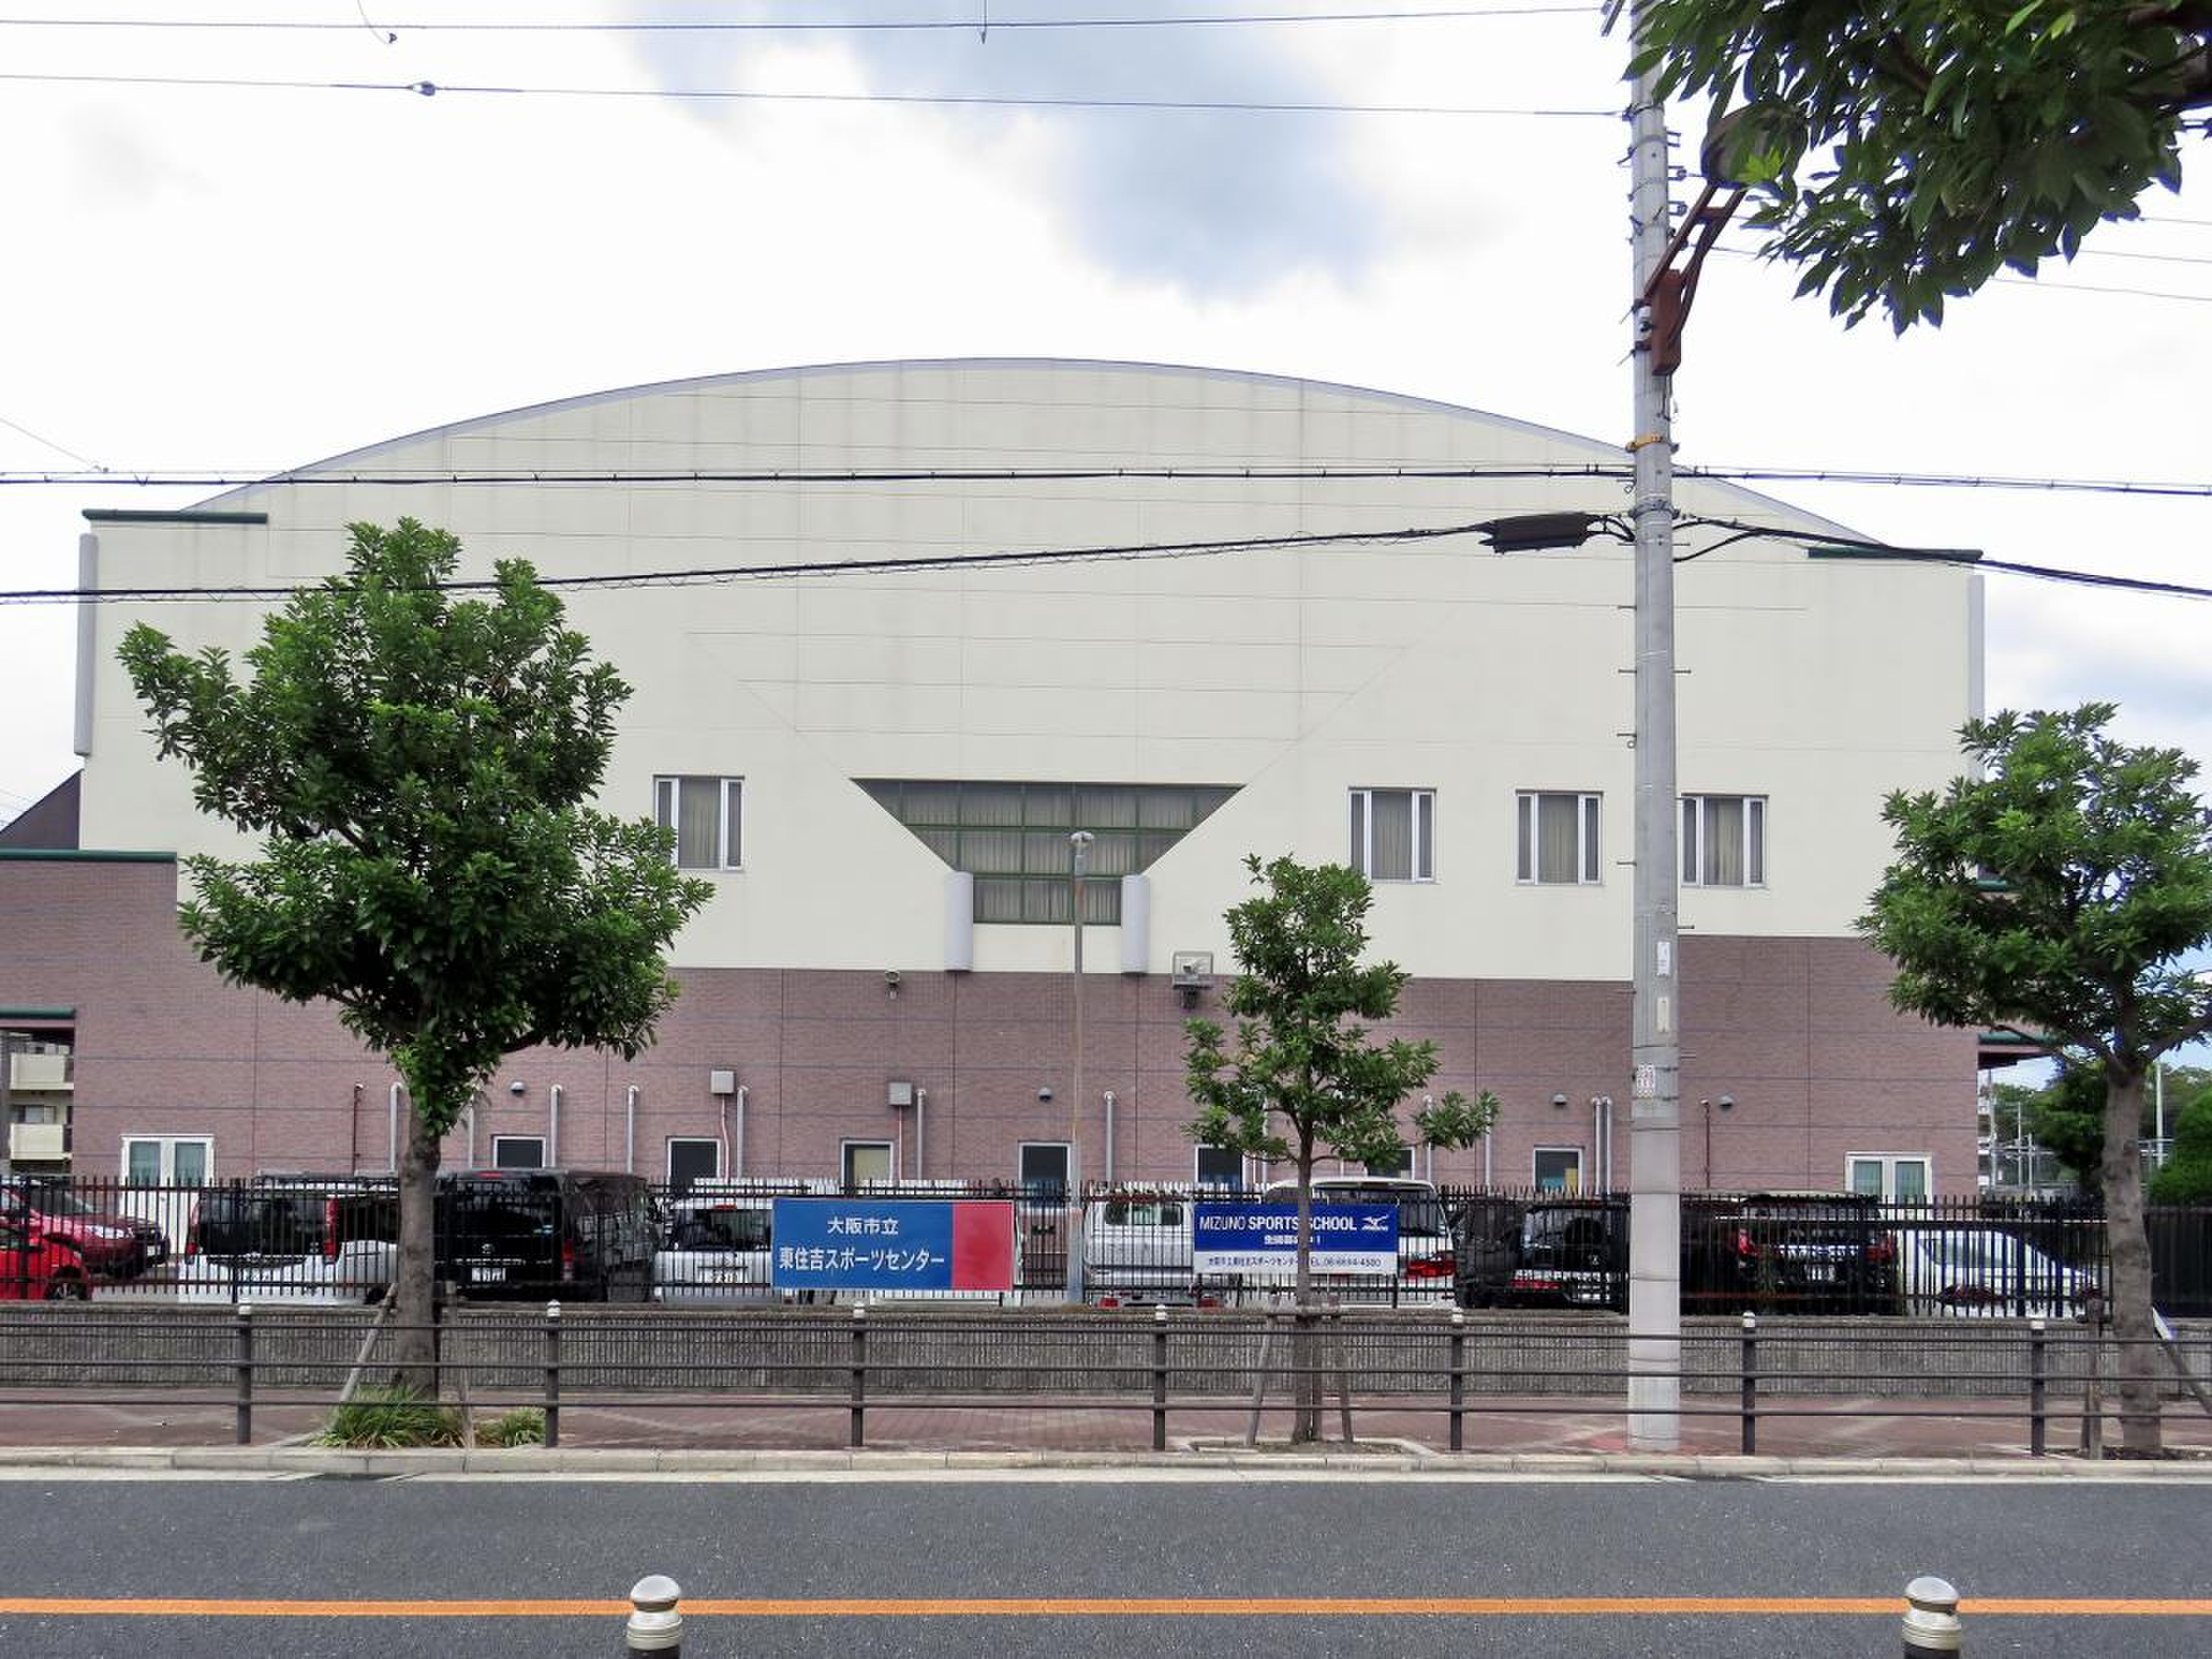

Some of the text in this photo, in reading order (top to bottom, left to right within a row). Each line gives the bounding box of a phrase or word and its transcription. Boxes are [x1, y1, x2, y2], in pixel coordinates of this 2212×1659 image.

[827, 1218, 900, 1235] 大阪市立
[1199, 1217, 1245, 1230] MIZUNO
[1248, 1216, 1299, 1230] SPORTS
[779, 1247, 945, 1271] 東住吉スポーツセンター
